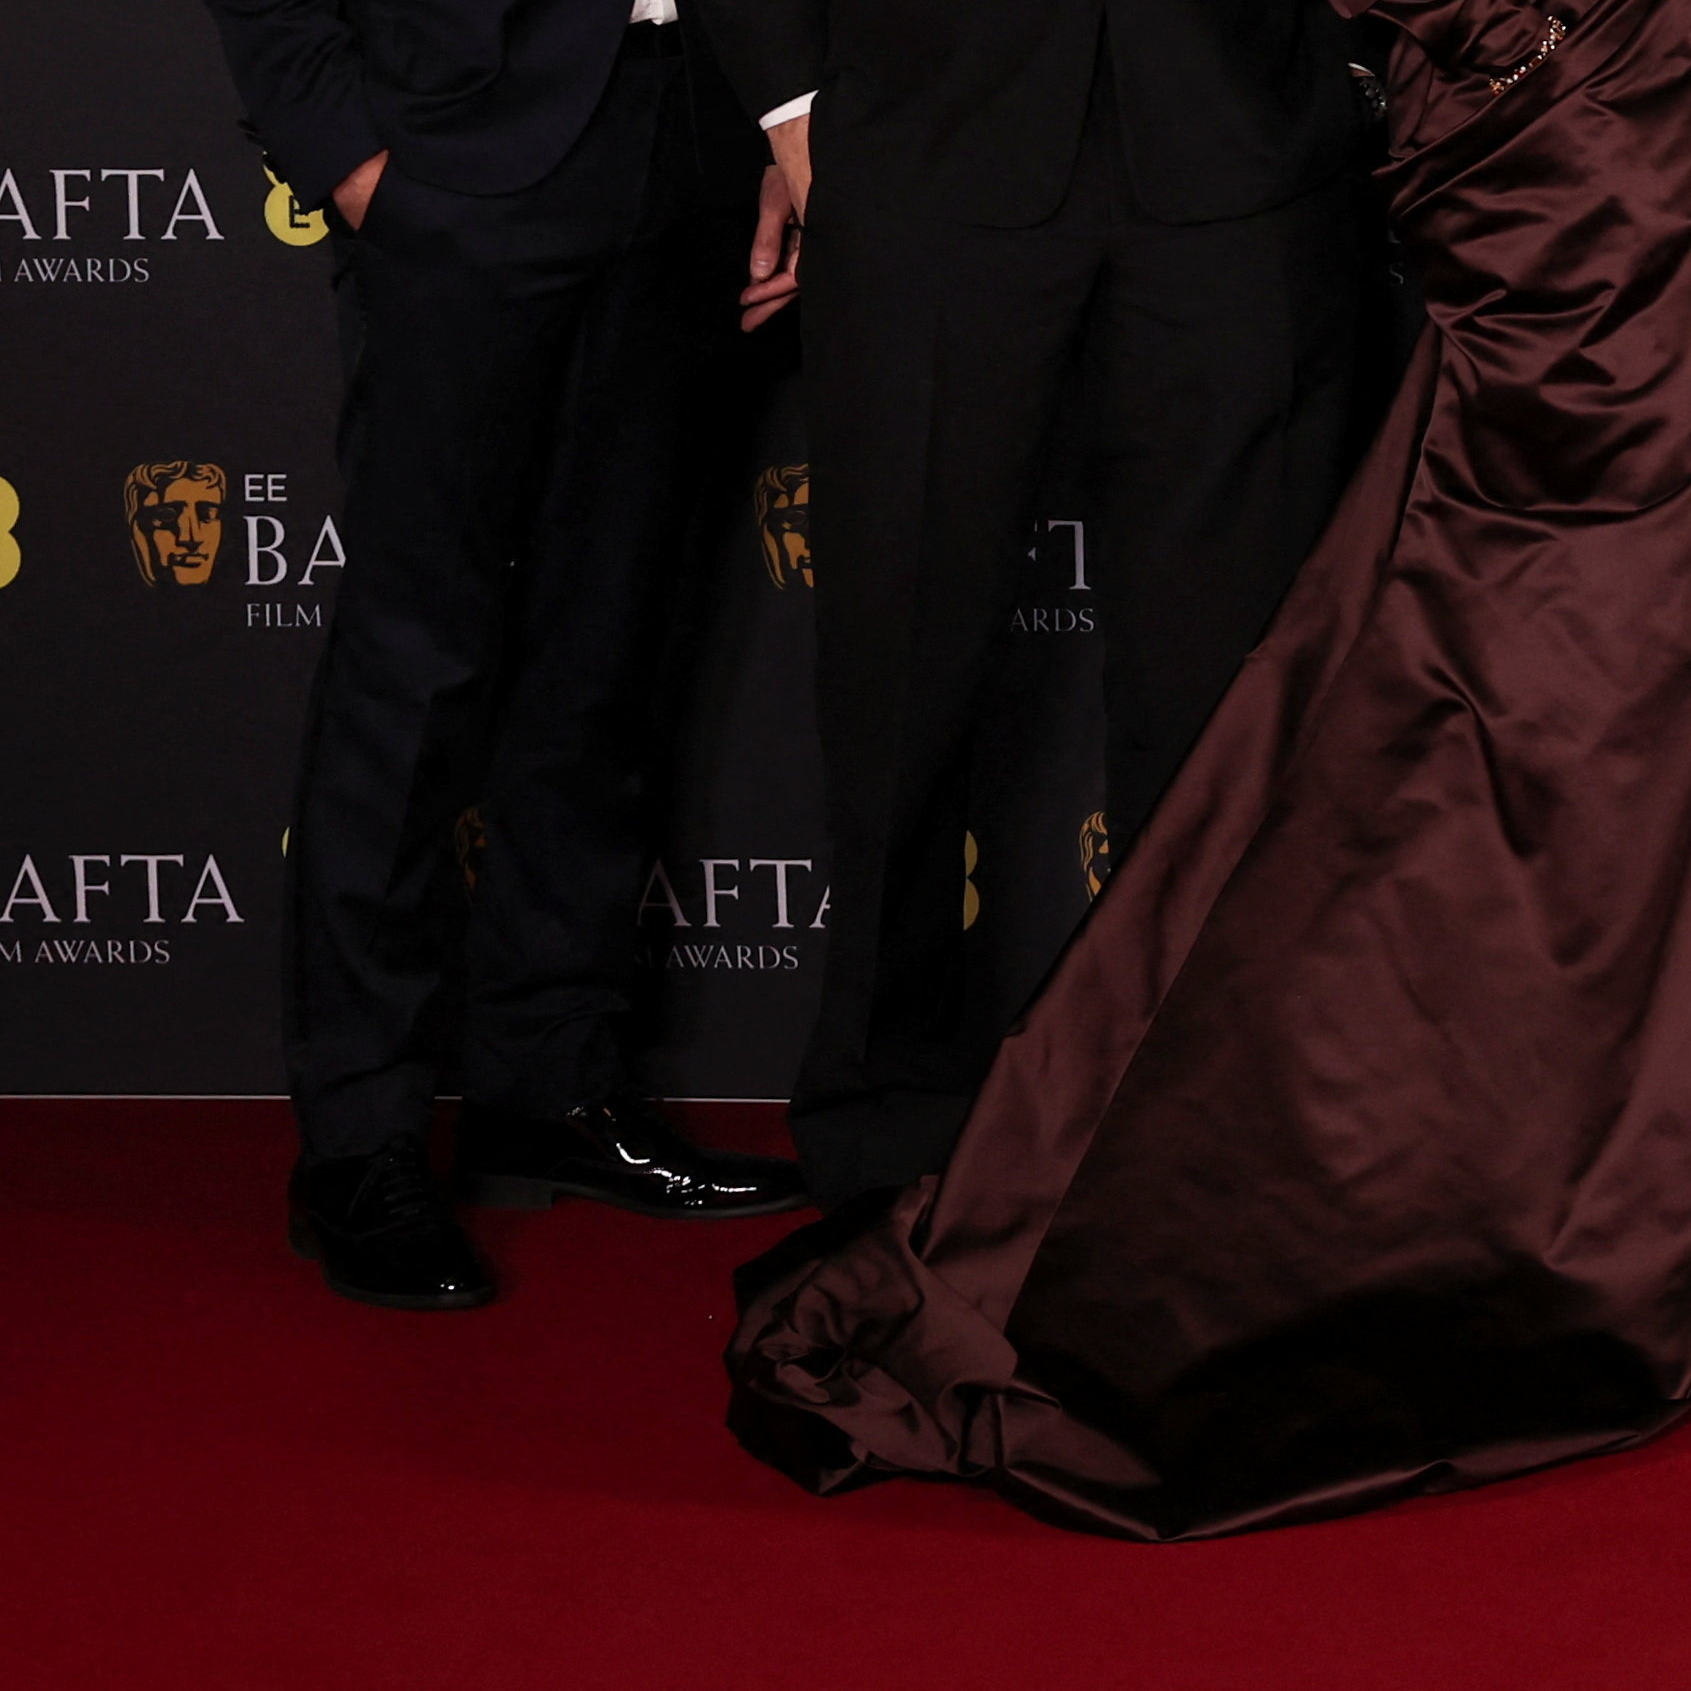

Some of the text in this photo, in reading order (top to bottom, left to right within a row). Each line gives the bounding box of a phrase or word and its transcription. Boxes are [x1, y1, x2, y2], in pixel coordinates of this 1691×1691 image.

[0, 167, 225, 240] AFTA
[14, 258, 150, 283] AWARDS
[244, 473, 288, 502] EE
[245, 603, 322, 628] FILM
[1009, 608, 1095, 633] ARDS
[0, 853, 245, 923] AFTA
[635, 855, 831, 929] AFT
[34, 939, 170, 964] AWARDS
[664, 944, 799, 970] AWARDS
